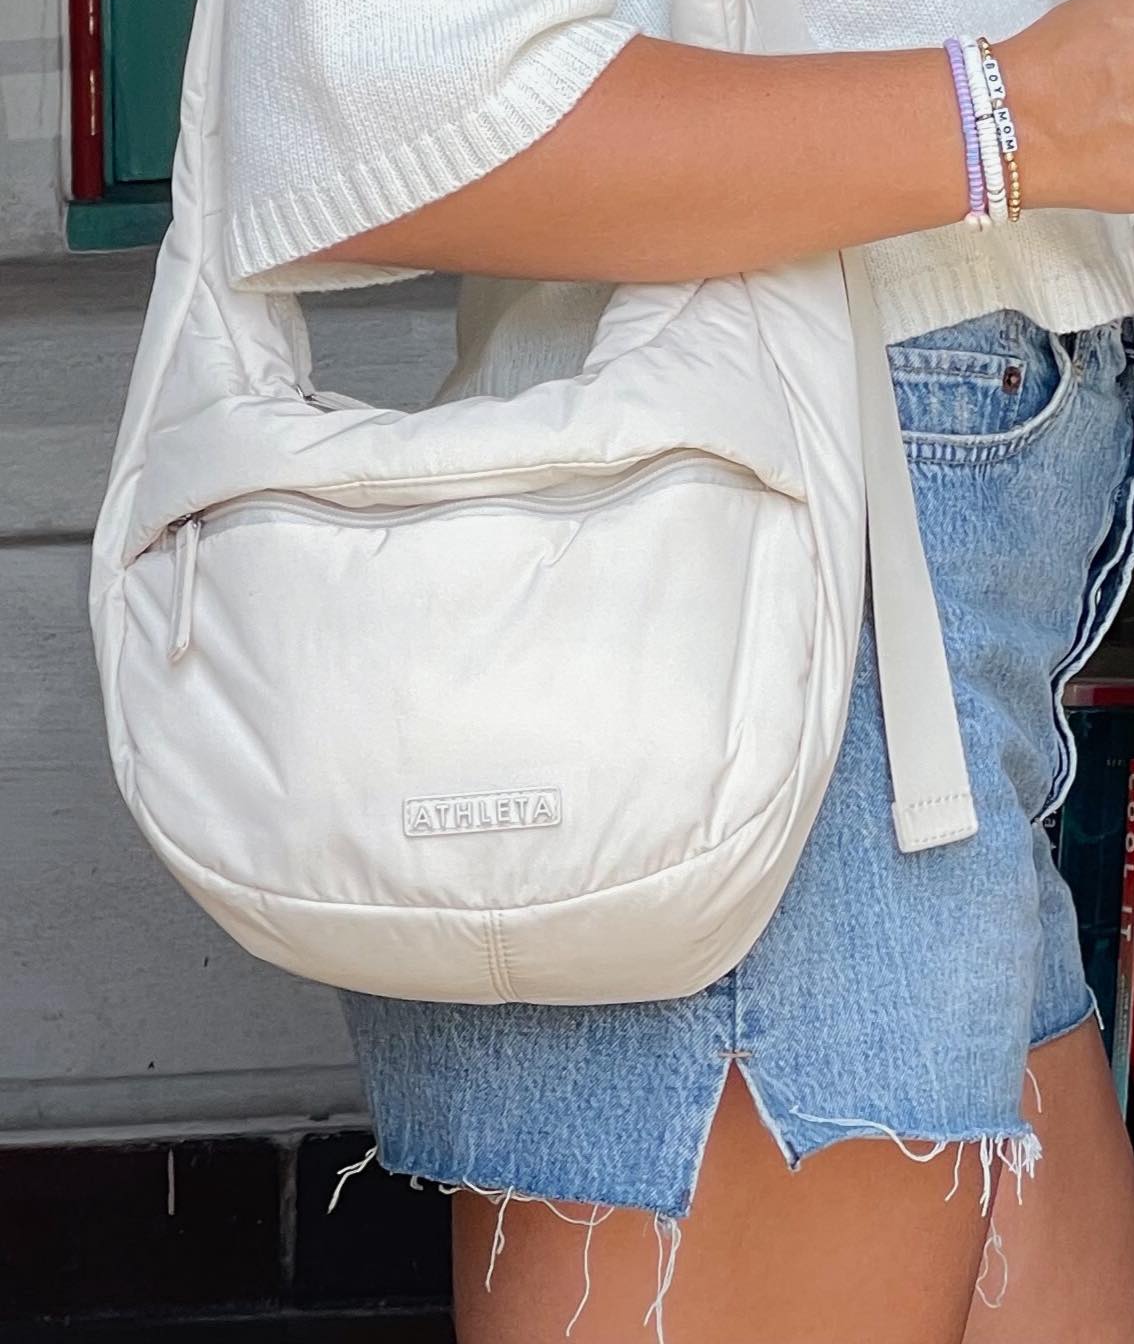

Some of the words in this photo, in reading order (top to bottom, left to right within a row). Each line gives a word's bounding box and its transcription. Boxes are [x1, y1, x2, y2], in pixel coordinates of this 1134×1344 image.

[986, 62, 1004, 95] BOY
[998, 110, 1015, 151] MOM
[411, 795, 553, 832] ATHLETA
[1120, 906, 1134, 943] IT
